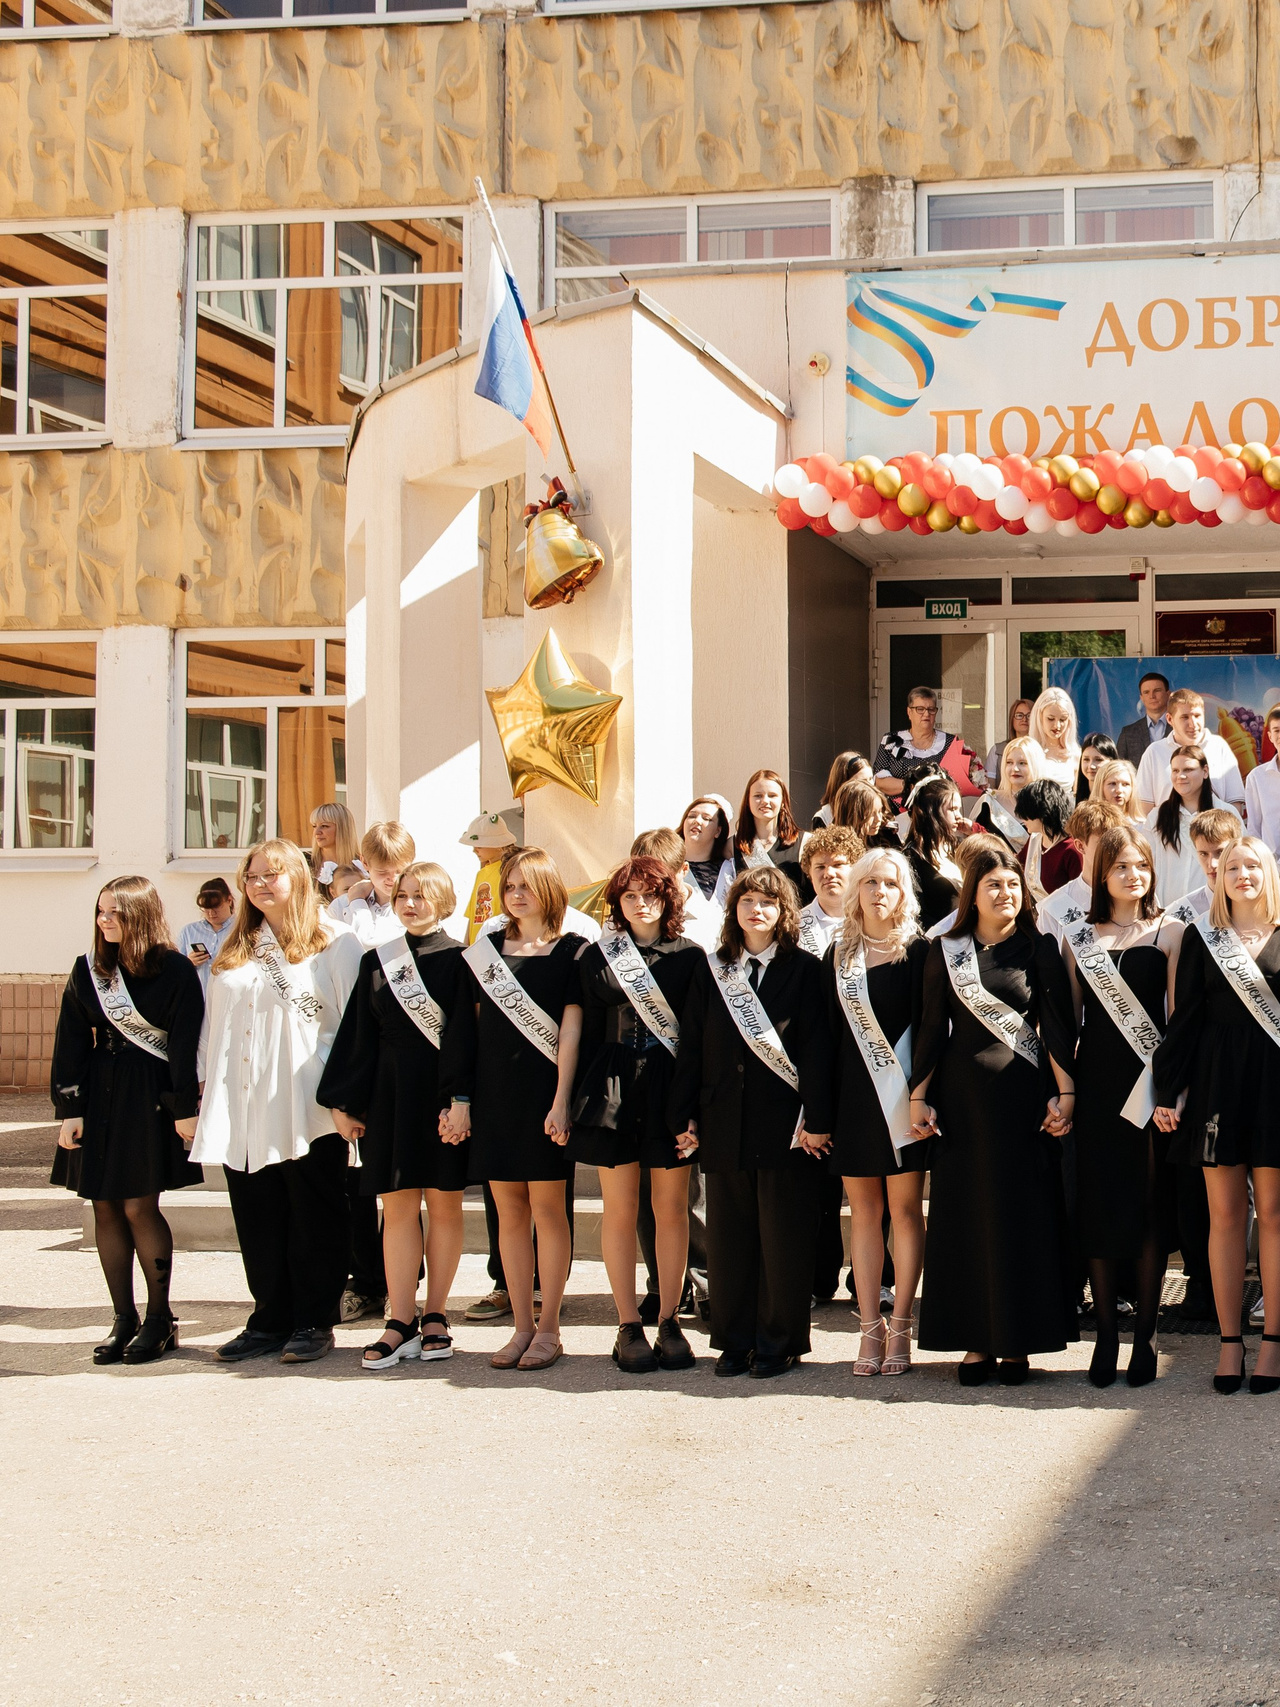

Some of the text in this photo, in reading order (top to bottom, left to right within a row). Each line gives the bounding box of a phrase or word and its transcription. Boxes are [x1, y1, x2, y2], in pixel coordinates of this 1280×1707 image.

[932, 603, 961, 616] ВХОД
[254, 936, 323, 1017] Выпускник 2025
[398, 984, 444, 1036] Выпус
[615, 959, 671, 1037] Выпускник
[840, 956, 895, 1067] Выпускник 2025
[955, 973, 1039, 1056] Выпускник 202
[1079, 945, 1161, 1050] Выпускник 2025
[1216, 945, 1280, 1028] Выпускница
[104, 995, 167, 1052] Выпускни
[492, 982, 559, 1056] Выпускник
